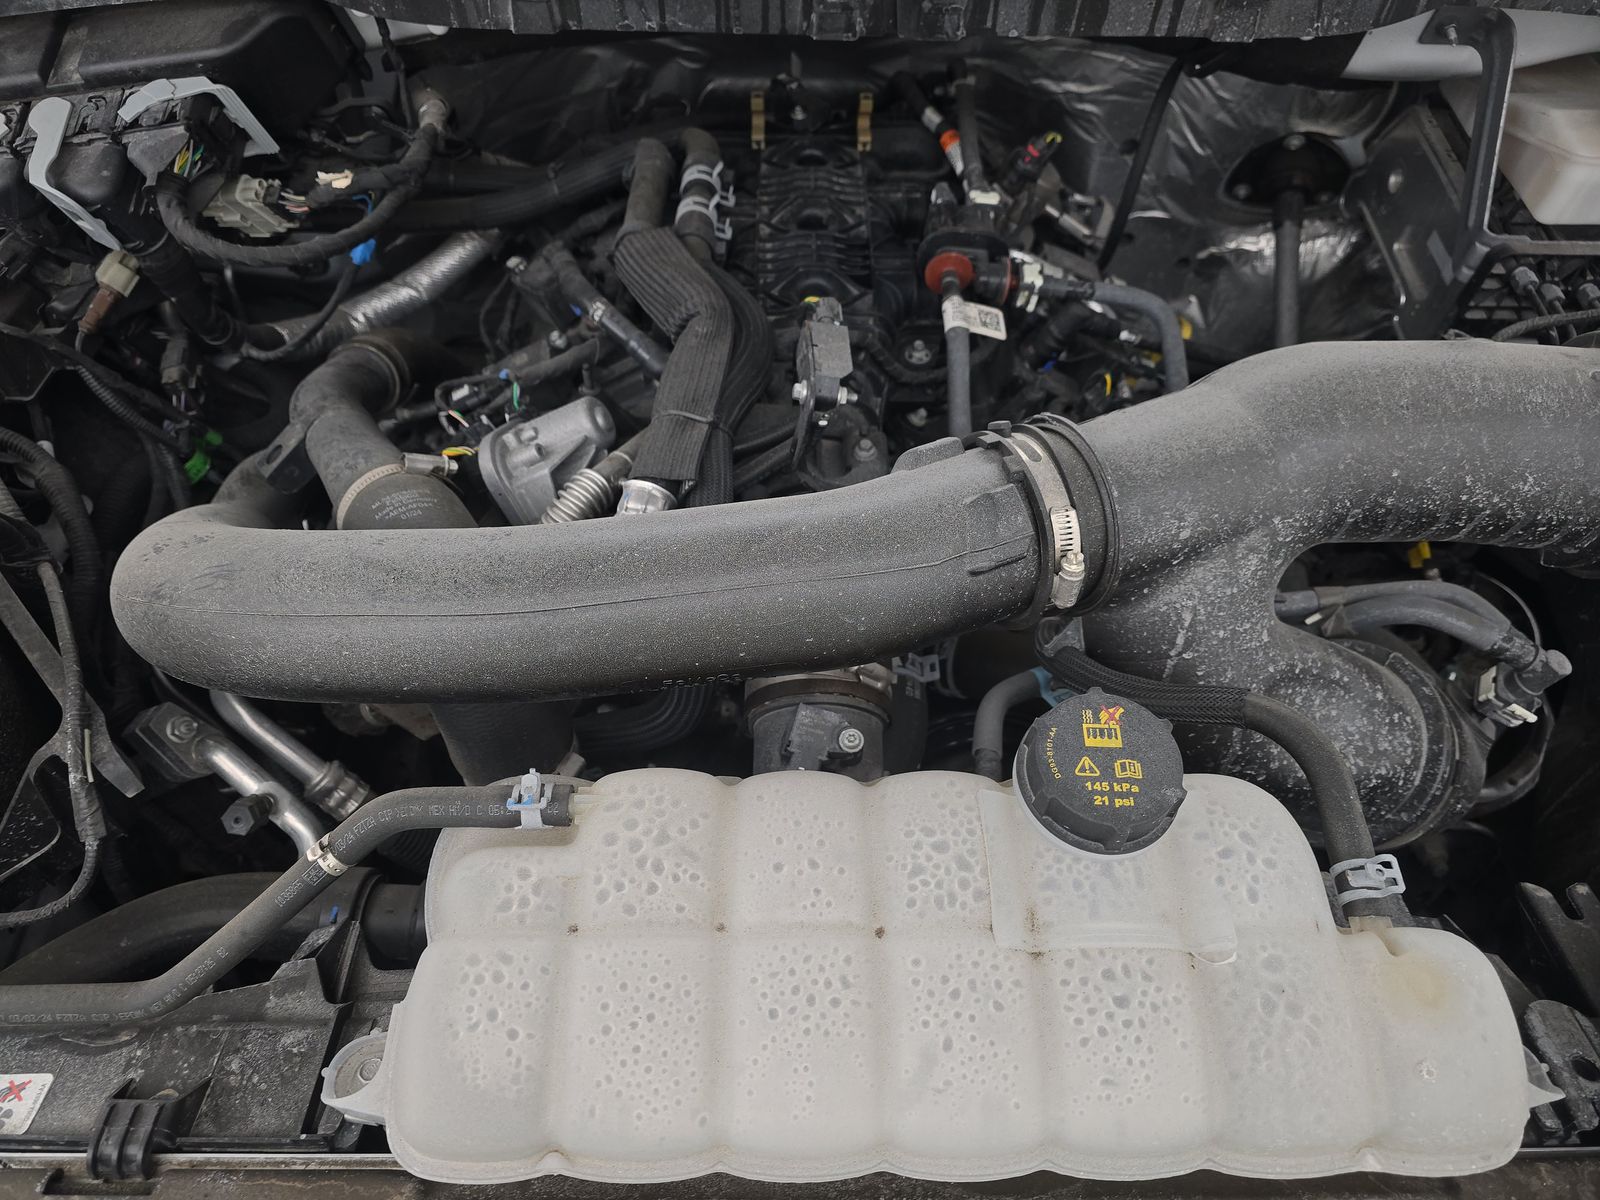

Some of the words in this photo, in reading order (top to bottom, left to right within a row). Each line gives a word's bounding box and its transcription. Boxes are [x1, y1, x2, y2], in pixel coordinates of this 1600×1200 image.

[1085, 781, 1110, 792] 145
[1113, 782, 1139, 793] kPa
[1093, 795, 1109, 806] 21
[1114, 796, 1135, 808] psi
